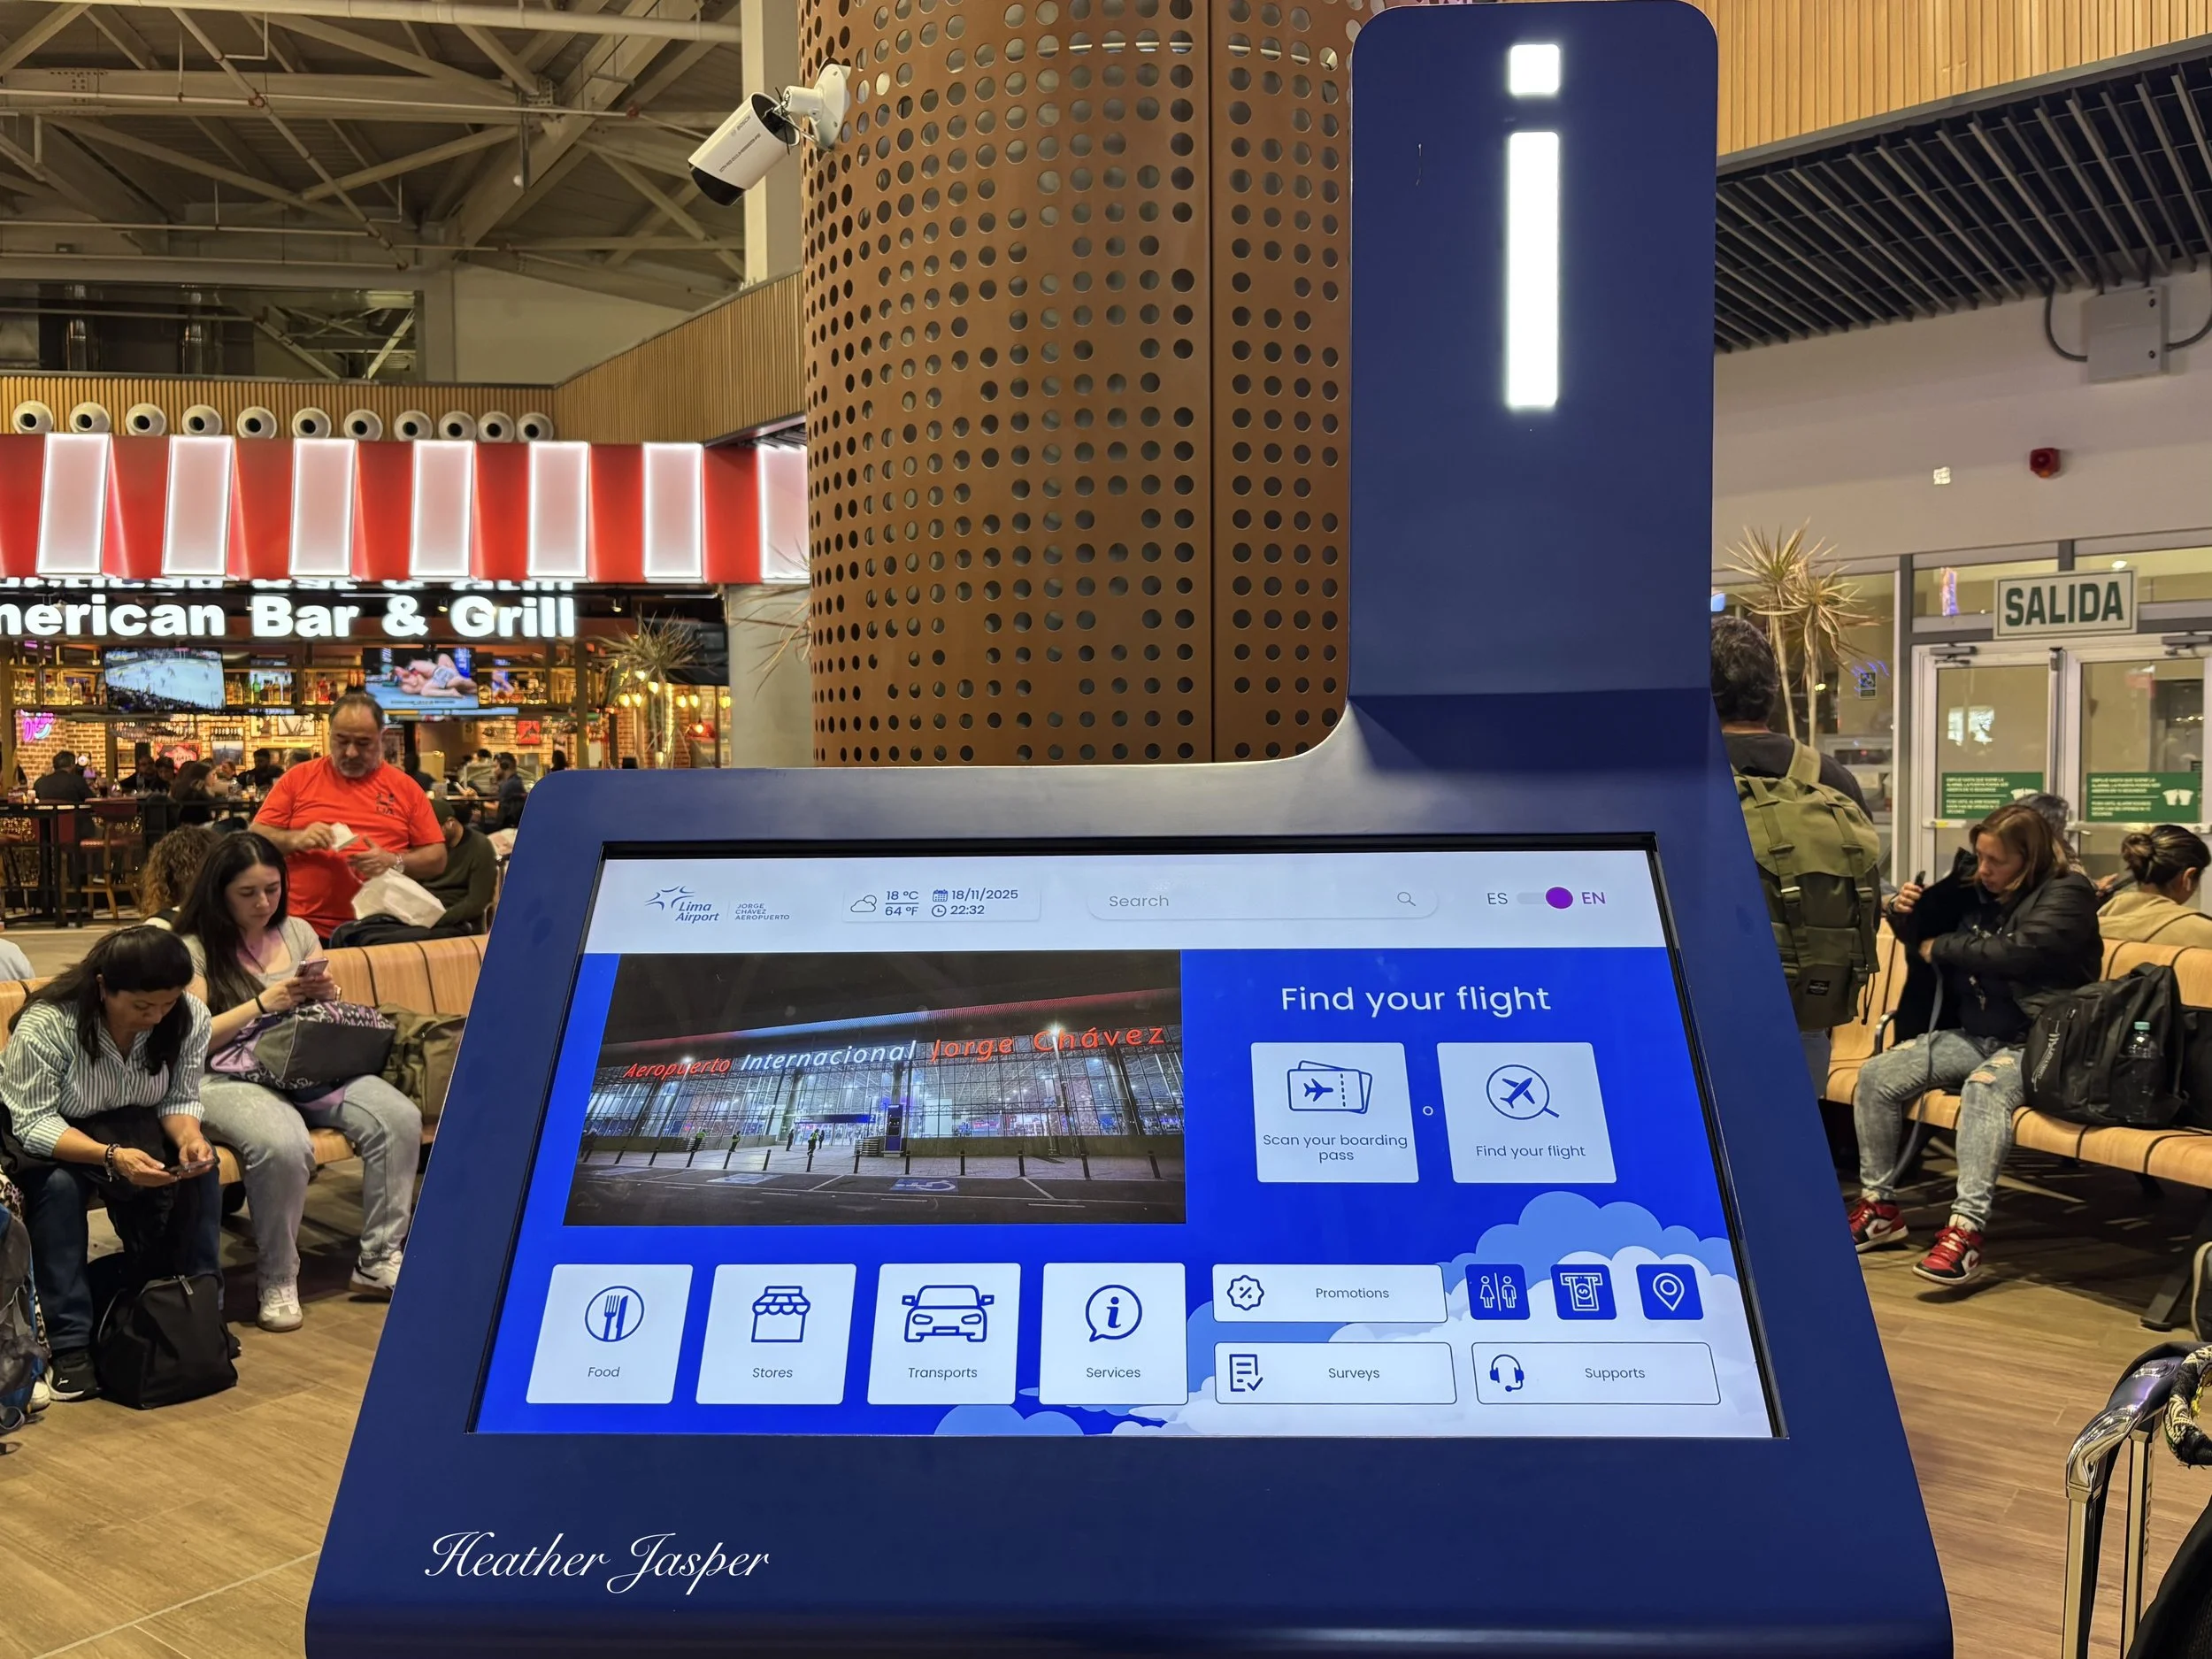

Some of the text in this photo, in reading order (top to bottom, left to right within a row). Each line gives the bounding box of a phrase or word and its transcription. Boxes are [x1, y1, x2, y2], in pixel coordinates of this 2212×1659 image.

[2005, 580, 2124, 627] SALIDA
[252, 595, 360, 637] Bar
[381, 595, 429, 638] &
[451, 595, 575, 638] Grill
[887, 890, 900, 901] 18
[951, 887, 1018, 902] 18/11/2025
[1109, 895, 1170, 907] Search
[1486, 892, 1509, 905] ES
[1581, 891, 1607, 905] EN
[679, 901, 712, 912] Lima
[885, 906, 902, 917] 64
[950, 904, 985, 915] 22:32
[675, 911, 720, 925] Airport
[1281, 986, 1552, 1018] Find your flight
[623, 1025, 1165, 1082] Aeropuerto Internacional Jorge Chávez
[1263, 1133, 1408, 1149] Scan your boarding
[1318, 1151, 1355, 1164] pass
[1476, 1145, 1586, 1161] Find your flight
[1315, 1286, 1390, 1300] Promotions
[588, 1365, 621, 1379] Food
[751, 1365, 794, 1379] Stores
[908, 1365, 979, 1381] Transports
[1086, 1365, 1142, 1379] Services
[1327, 1366, 1381, 1381] Surveys
[1585, 1366, 1646, 1381] Supports
